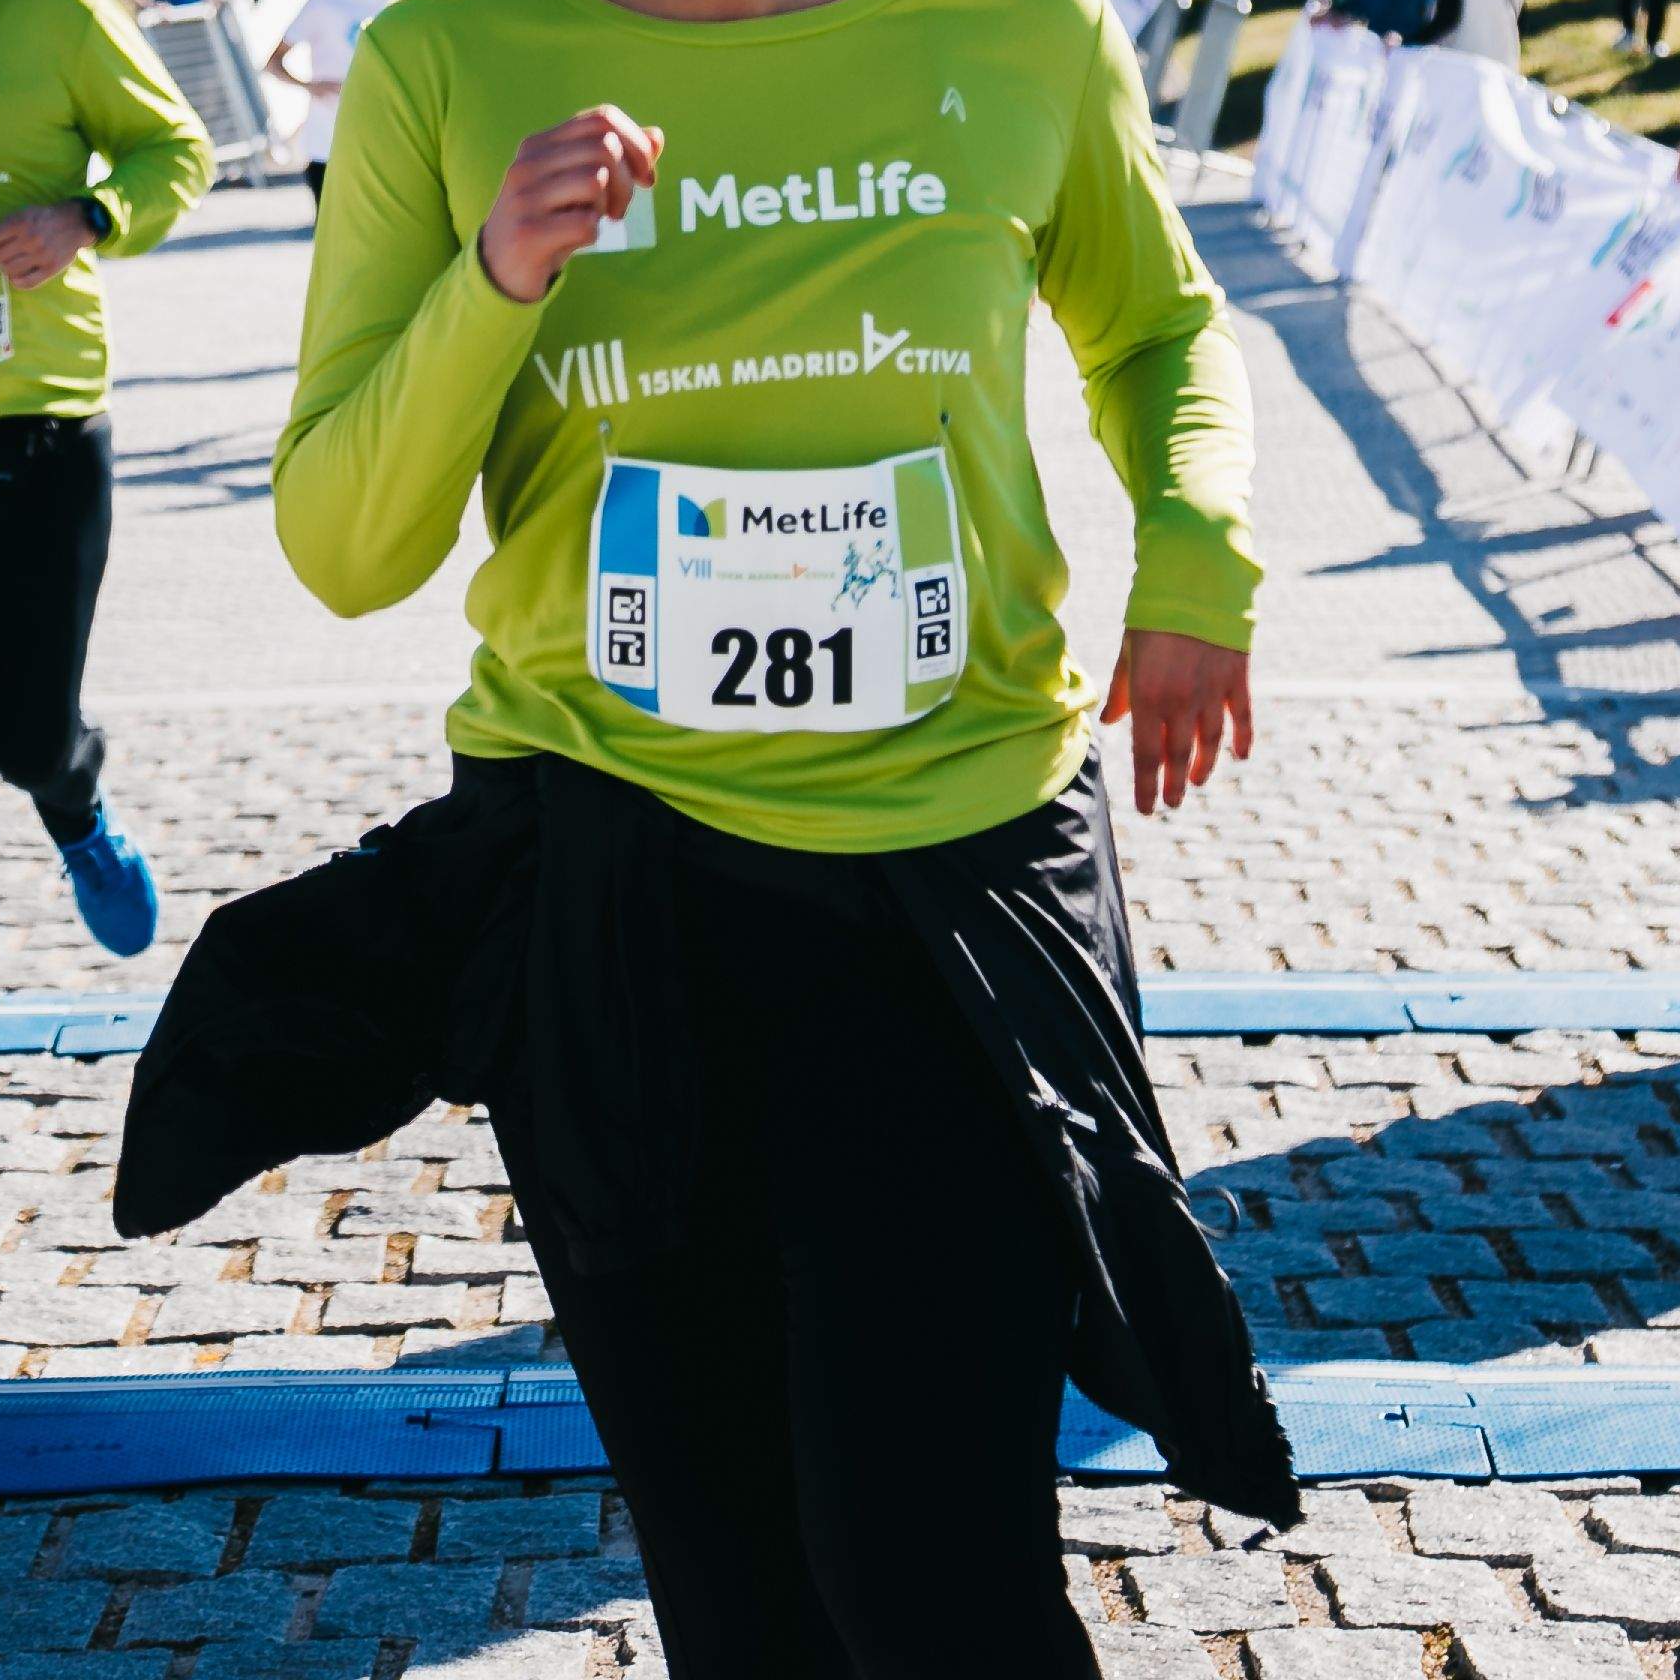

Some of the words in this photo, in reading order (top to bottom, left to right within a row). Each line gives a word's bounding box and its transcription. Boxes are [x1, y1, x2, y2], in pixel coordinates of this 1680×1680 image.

[679, 161, 948, 233] MetLife
[535, 340, 628, 409] VIII
[637, 365, 721, 398] 15KM
[741, 500, 888, 535] MetLife
[711, 626, 854, 708] 281
